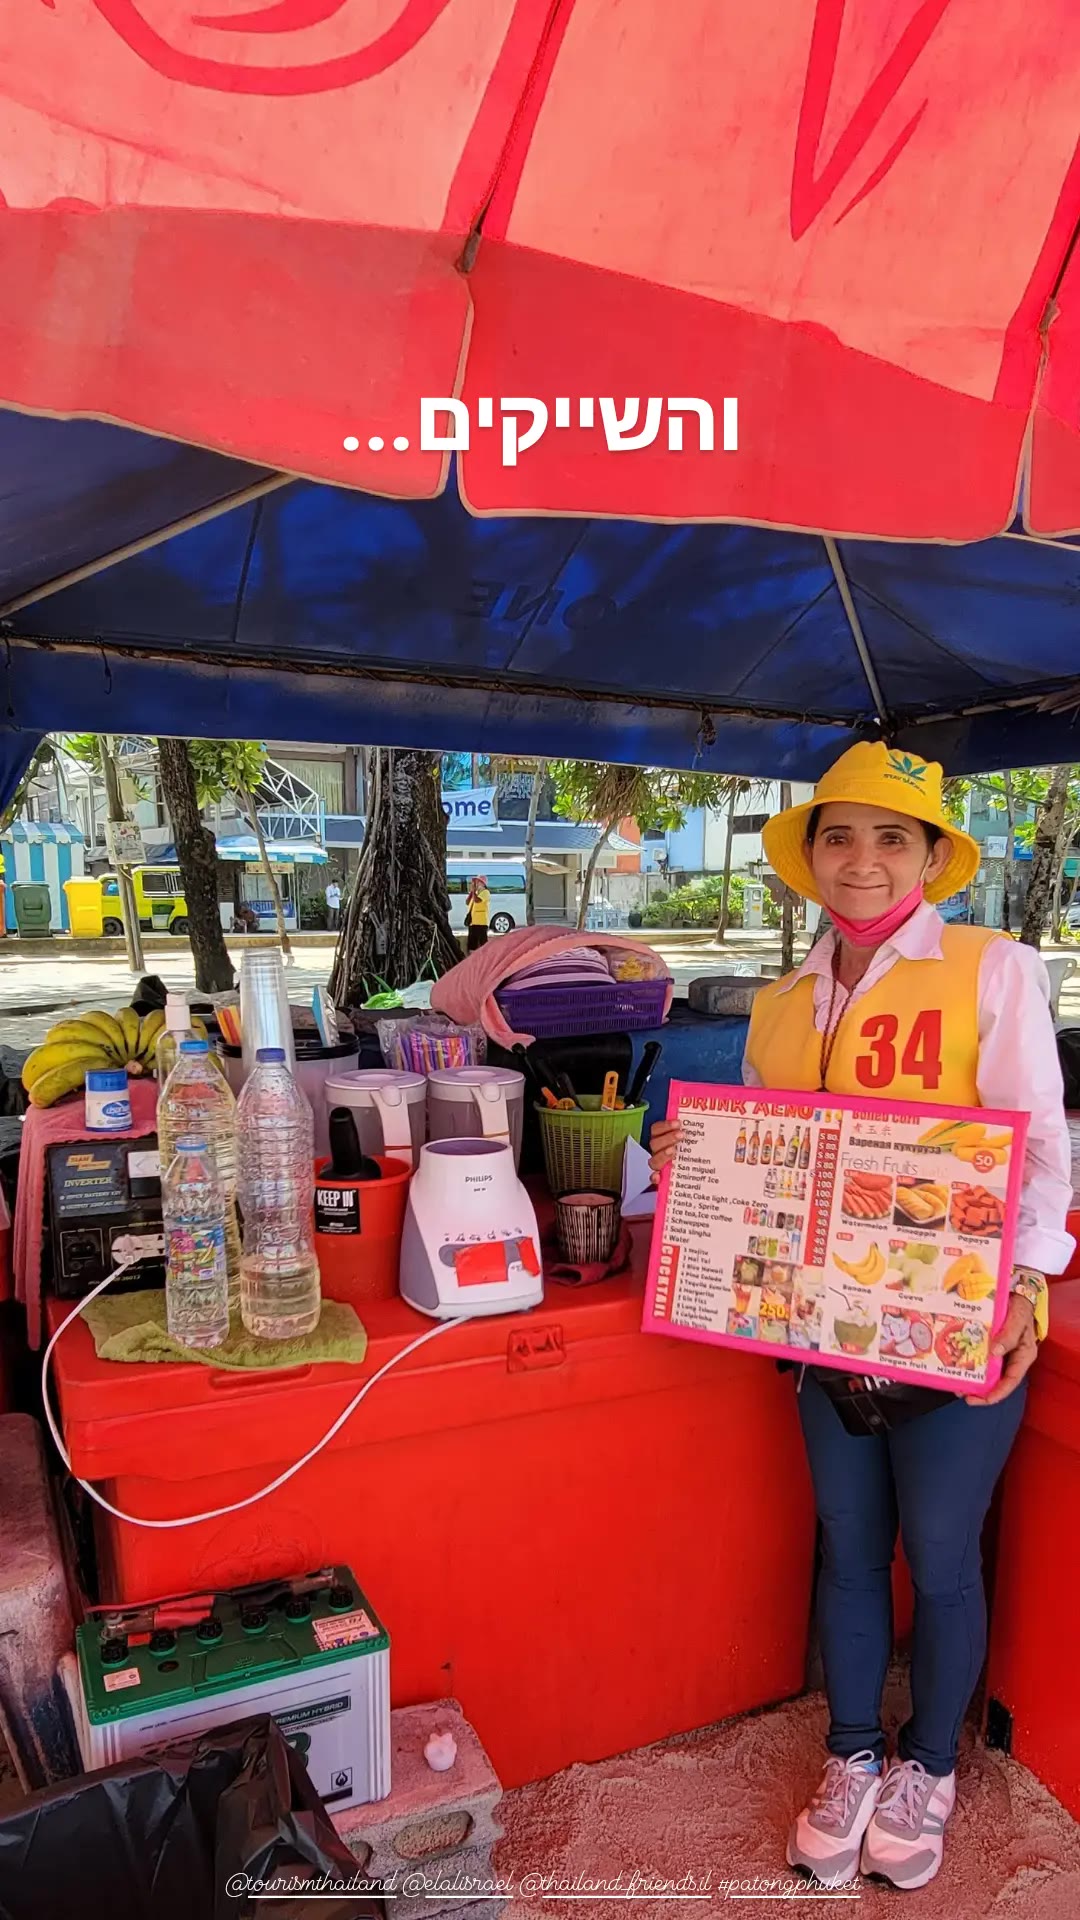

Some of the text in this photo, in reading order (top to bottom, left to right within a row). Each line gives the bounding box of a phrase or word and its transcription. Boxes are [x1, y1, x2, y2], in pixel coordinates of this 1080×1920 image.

[855, 1009, 942, 1090] 34
[678, 1096, 747, 1116] DRINK
[682, 1119, 705, 1129] Chang
[680, 1145, 692, 1153] Leo
[678, 1155, 711, 1164] Heineken
[840, 1151, 878, 1171] Fresh
[882, 1156, 919, 1175] Fruits
[975, 1154, 993, 1166] 50
[64, 1177, 112, 1187] INVERTER
[675, 1181, 701, 1190] Bacardi
[317, 1189, 341, 1207] KEEP
[698, 1203, 720, 1211] Sprite
[751, 1200, 769, 1208] Zero
[671, 1217, 710, 1228] Schweppes
[710, 1214, 733, 1223] coffee
[841, 1219, 888, 1231] Watermelon
[670, 1225, 711, 1238] Soda singha
[896, 1227, 936, 1238] Pineapple
[669, 1234, 690, 1243] Water
[957, 1235, 990, 1245] Papaya
[653, 1245, 674, 1317] COCKTAIL
[842, 1283, 871, 1294] Banana
[953, 1301, 982, 1312] Mango
[879, 1356, 928, 1370] Dragon fruit
[936, 1366, 985, 1380] Mixed fruit
[276, 1710, 311, 1725] REMIUM
[311, 1702, 344, 1716] HYBRID
